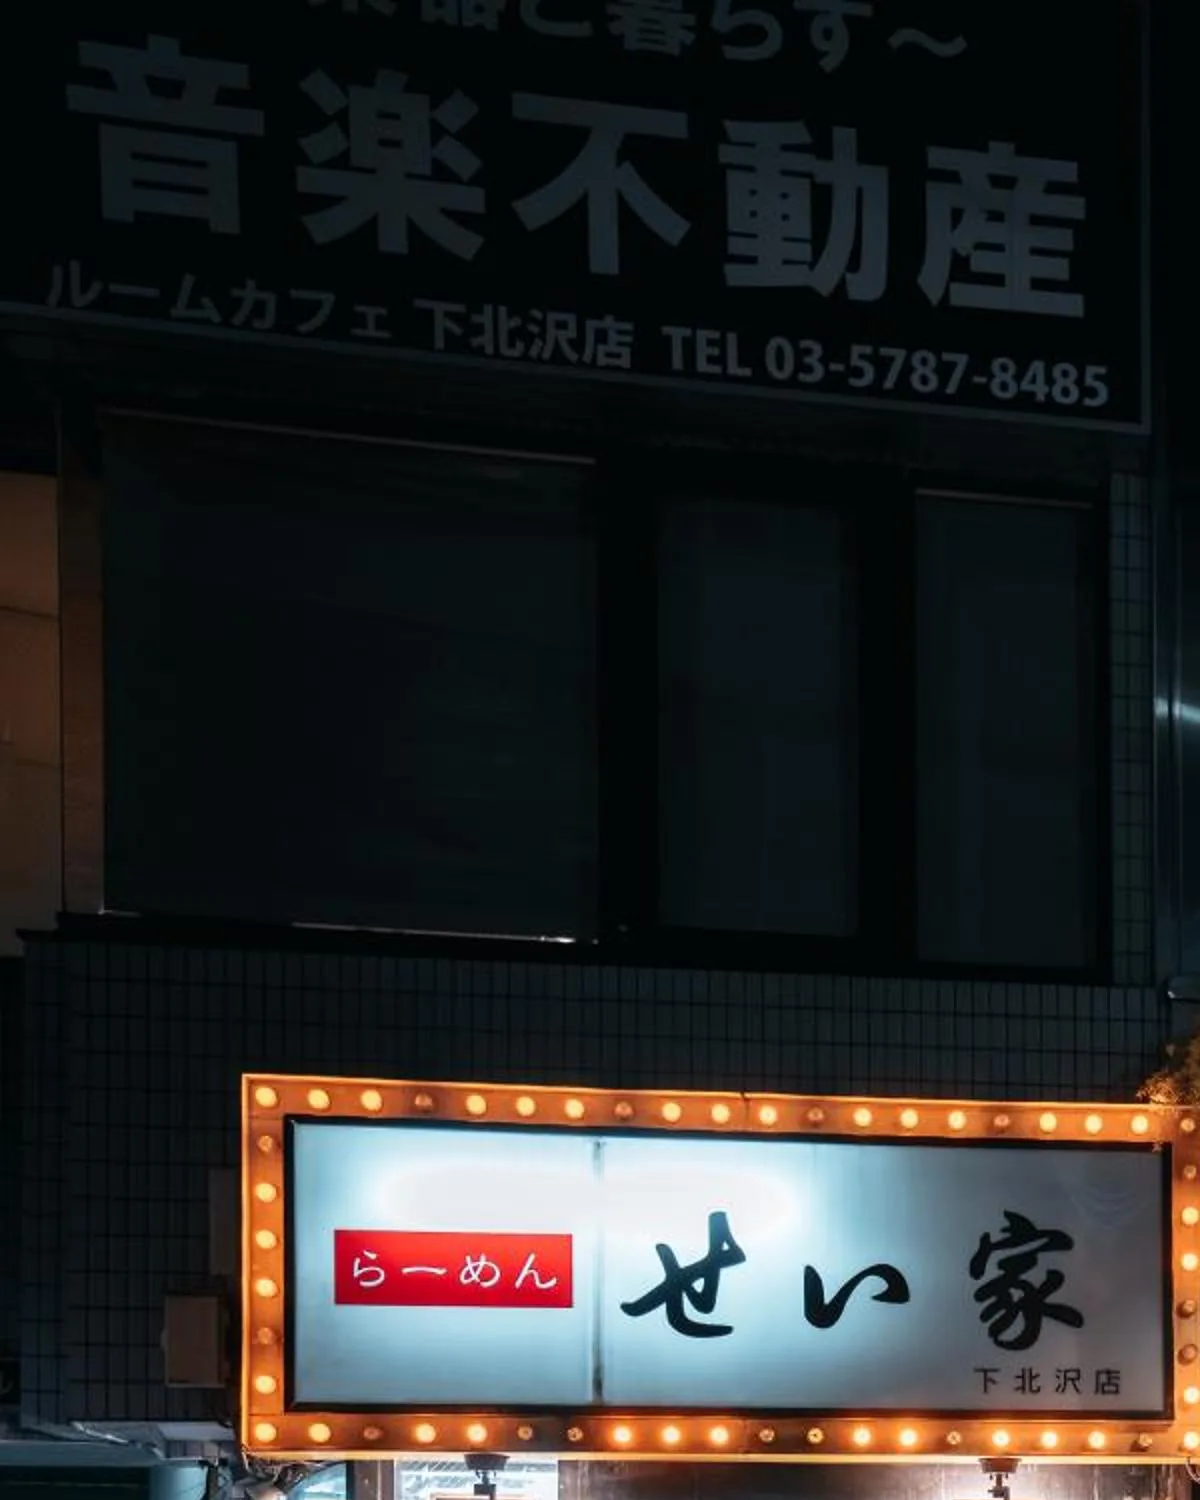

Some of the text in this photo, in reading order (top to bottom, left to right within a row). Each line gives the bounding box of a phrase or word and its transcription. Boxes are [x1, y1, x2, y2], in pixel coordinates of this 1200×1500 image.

[65, 34, 1086, 319] 音楽不動産
[44, 258, 1110, 407] ルームカフェ 下北沢店 TEL 03-5787-8485
[352, 1251, 556, 1289] らーめん
[620, 1210, 1084, 1352] せい家
[974, 1367, 1121, 1396] 下北沢店
